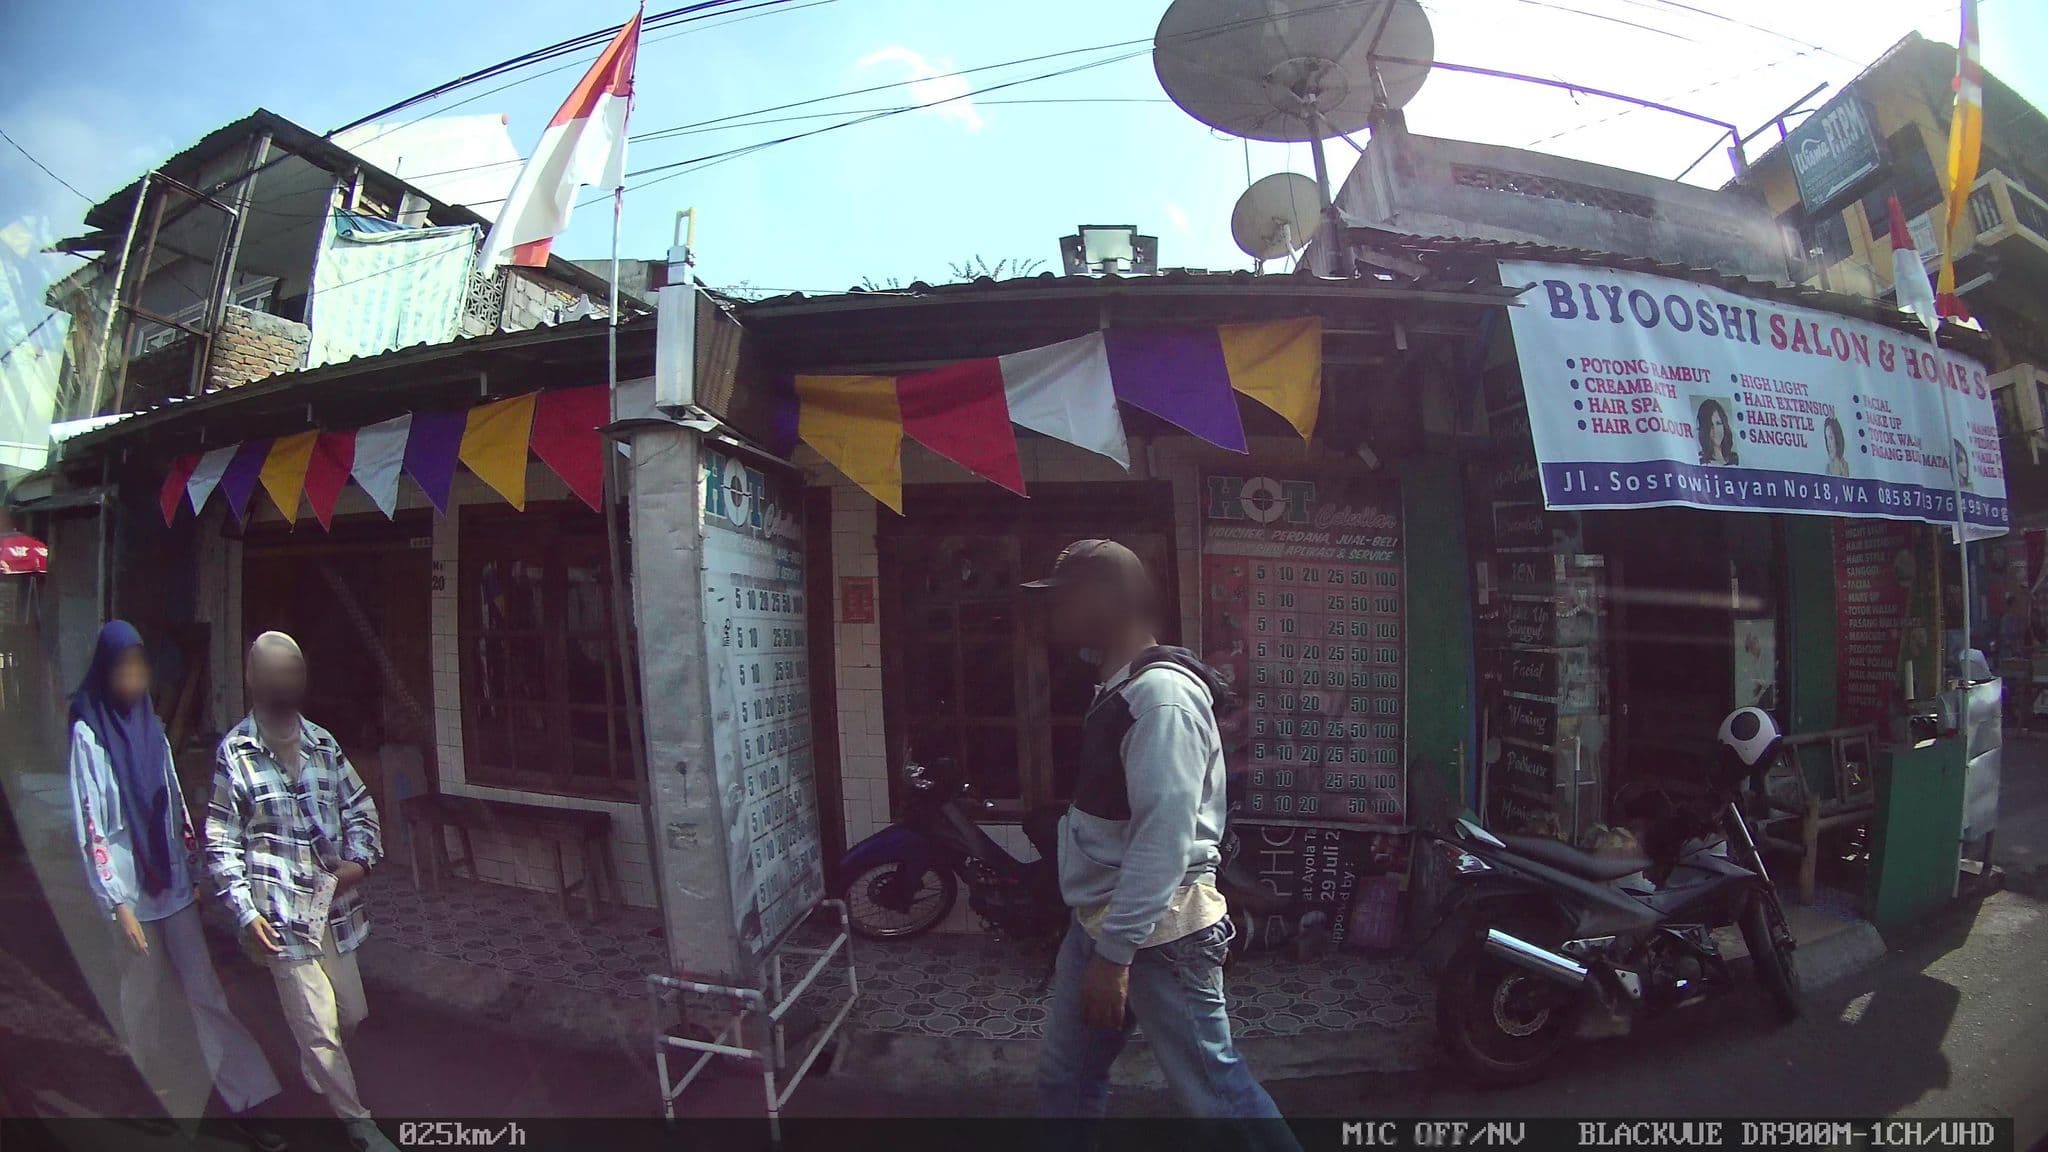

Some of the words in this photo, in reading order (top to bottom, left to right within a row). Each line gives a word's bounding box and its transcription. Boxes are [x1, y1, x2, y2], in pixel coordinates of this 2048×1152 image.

[1542, 279, 1760, 345] BIYOOSHI
[1769, 314, 1871, 367] SALON
[1878, 339, 1896, 372] &
[1580, 357, 1649, 376] POTONG
[1651, 362, 1711, 383] RAMBUT
[1585, 377, 1677, 399] CREAMBATH
[1739, 373, 1773, 391] HIGH
[1773, 379, 1809, 396] LIGHT
[1588, 397, 1628, 415] HAIR
[1632, 397, 1663, 414] SPA
[1743, 391, 1776, 409] HAIR
[1776, 397, 1836, 418] EXTENSION
[1592, 418, 1632, 434] HAIR
[1636, 417, 1694, 438] COLOUR
[1746, 410, 1778, 427] HAIR
[1780, 414, 1815, 432] STYLE
[1890, 417, 1902, 430] UP
[1749, 429, 1808, 448] SANGGUL
[1564, 470, 1600, 492] Jl.
[1609, 471, 1777, 500] Sosrowijayan
[1208, 476, 1316, 526] HOT
[1335, 534, 1398, 548] JUAL-BELI
[1348, 548, 1393, 561] SERVICE
[1257, 566, 1266, 579] 5
[1280, 566, 1294, 581] 10
[1303, 567, 1320, 582] 20
[1328, 569, 1345, 584] 25
[1351, 570, 1368, 585] 50
[1375, 571, 1397, 586] 100
[1257, 592, 1266, 606] 5
[1280, 593, 1294, 607] 10
[1328, 595, 1345, 610] 25
[1351, 597, 1368, 612] 50
[1375, 598, 1397, 613] 100
[1257, 617, 1266, 631] 5
[1280, 618, 1294, 633] 10
[1328, 621, 1345, 635] 25
[1351, 622, 1368, 637] 50
[1375, 624, 1397, 638] 100
[1257, 643, 1266, 656] 5
[1280, 644, 1294, 658] 10
[1303, 645, 1320, 659] 20
[1328, 646, 1345, 661] 25
[1351, 647, 1368, 662] 50
[1375, 648, 1397, 663] 100
[1257, 668, 1266, 682] 5
[1280, 669, 1294, 684] 10
[1303, 670, 1320, 684] 20
[1328, 671, 1345, 686] 30
[1351, 673, 1368, 687] 50
[1375, 674, 1397, 688] 100
[1257, 694, 1266, 707] 5
[1280, 695, 1294, 709] 10
[1303, 696, 1320, 710] 20
[1351, 698, 1368, 712] 50
[1375, 699, 1397, 714] 100
[1256, 720, 1266, 733] 5
[1280, 721, 1294, 735] 10
[1302, 722, 1320, 736] 20
[1328, 723, 1344, 737] 25
[1350, 724, 1368, 738] 50
[1374, 725, 1396, 739] 100
[1256, 745, 1265, 759] 5
[1279, 746, 1293, 760] 10
[1302, 747, 1319, 761] 20
[1327, 748, 1344, 762] 25
[1350, 749, 1367, 763] 50
[1374, 750, 1396, 764] 100
[1256, 771, 1264, 784] 5
[1278, 772, 1292, 786] 10
[1326, 774, 1344, 788] 25
[1350, 775, 1366, 788] 50
[1374, 776, 1396, 790] 100
[1255, 796, 1264, 809] 5
[1278, 797, 1292, 811] 10
[1301, 798, 1318, 812] 20
[1349, 799, 1366, 814] 50
[1373, 800, 1395, 814] 100
[1325, 830, 1340, 841] 2
[1302, 845, 1317, 883] Ayola
[1323, 845, 1340, 877] Juli
[1340, 871, 1356, 888] by
[1302, 885, 1312, 902] at
[1320, 880, 1336, 901] 29
